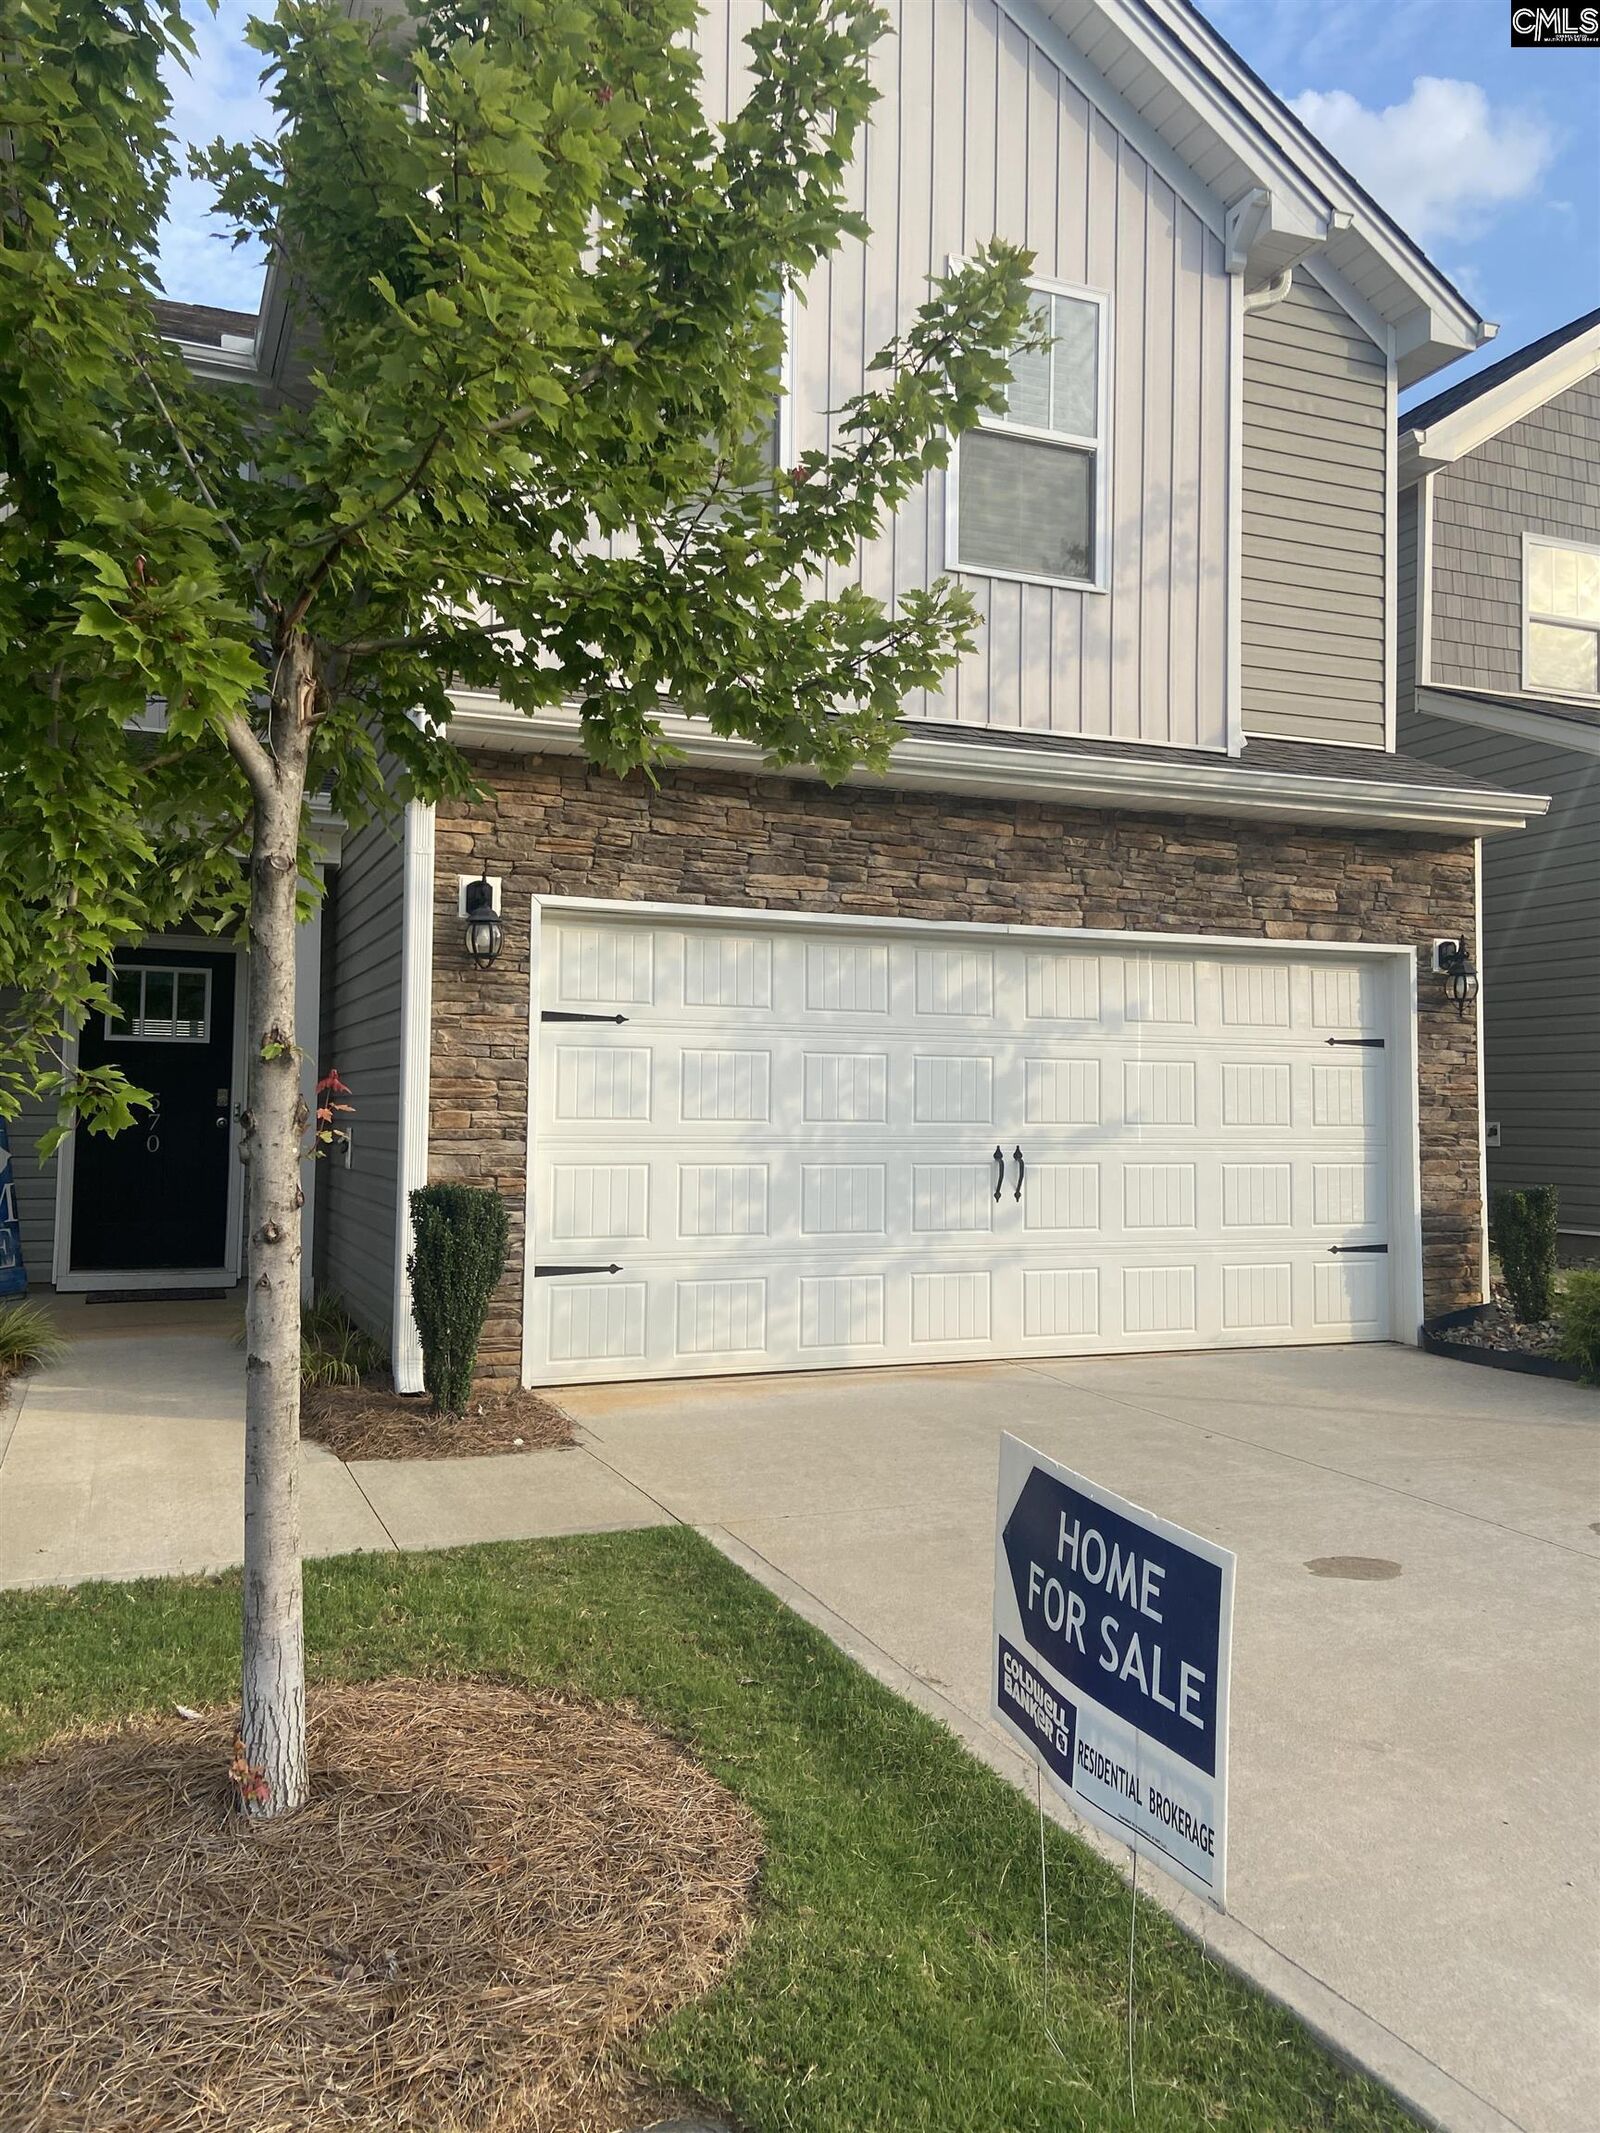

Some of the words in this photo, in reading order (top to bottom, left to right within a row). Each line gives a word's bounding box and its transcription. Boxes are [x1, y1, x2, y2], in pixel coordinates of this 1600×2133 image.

[1057, 1510, 1166, 1624] HOME
[1003, 1651, 1069, 1734] COLDWELL
[1028, 1561, 1086, 1655] FOR
[1099, 1615, 1206, 1730] SALE
[1004, 1670, 1054, 1743] BANKER
[1077, 1739, 1143, 1806] RESIDENTIAL
[1149, 1786, 1215, 1858] BROKERAGE
